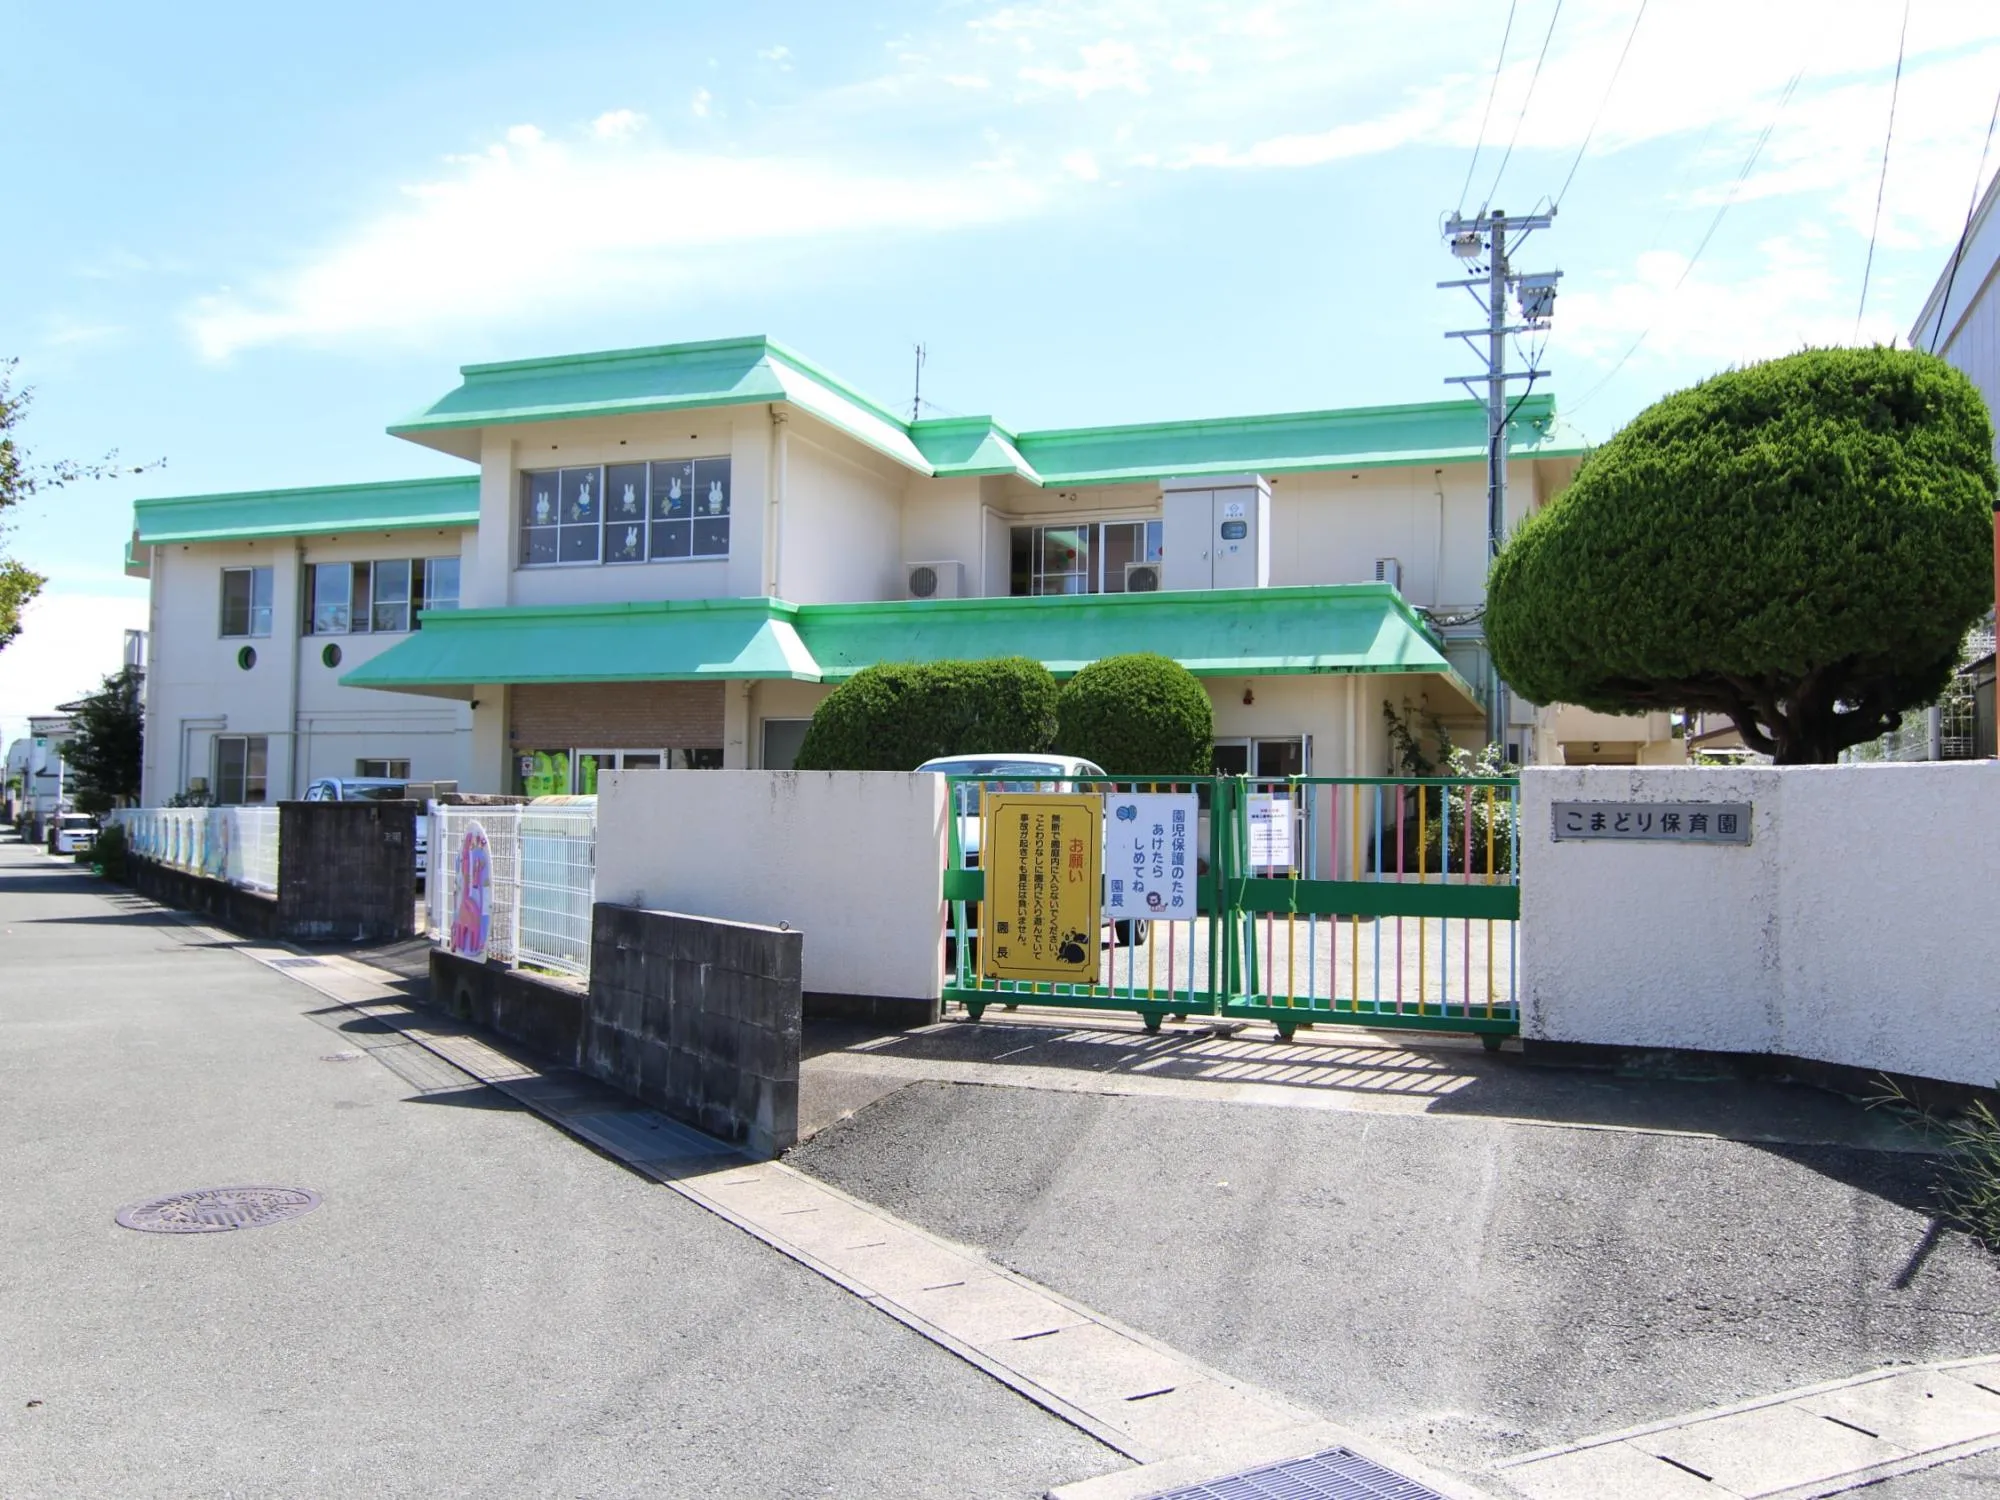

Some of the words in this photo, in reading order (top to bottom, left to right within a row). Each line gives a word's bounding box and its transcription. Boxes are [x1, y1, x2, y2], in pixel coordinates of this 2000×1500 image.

[1567, 811, 1737, 834] こまどり保育園
[1068, 838, 1084, 883] お願い
[1132, 838, 1145, 893] しめてね
[1151, 823, 1164, 879] あけたら
[1171, 809, 1185, 908] 園児保護のため
[1111, 879, 1124, 908] 園長
